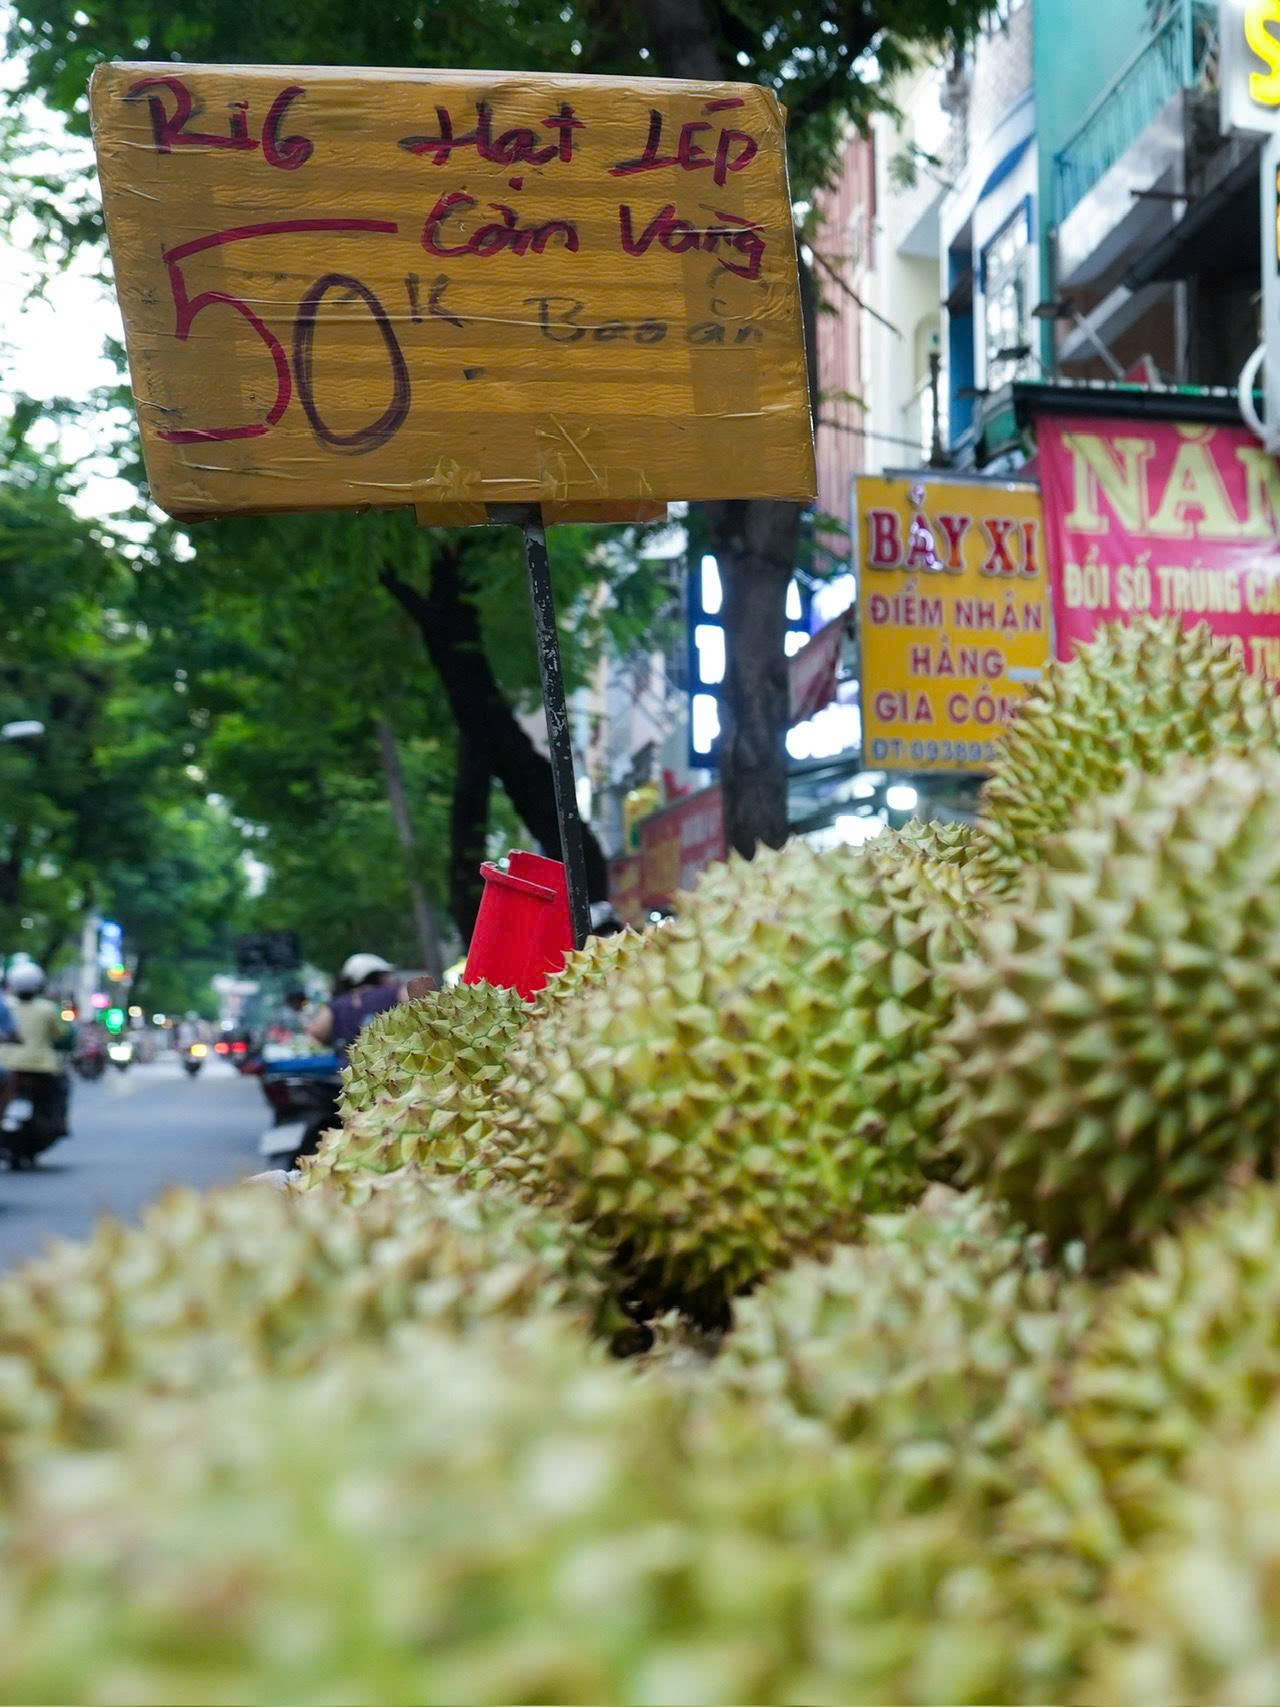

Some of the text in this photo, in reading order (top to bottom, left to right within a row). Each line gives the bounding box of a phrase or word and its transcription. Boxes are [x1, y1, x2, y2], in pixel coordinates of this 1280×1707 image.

[982, 517, 1040, 576] XI
[954, 589, 1043, 640] NHẬN
[874, 684, 1019, 724] GIA CÔN
